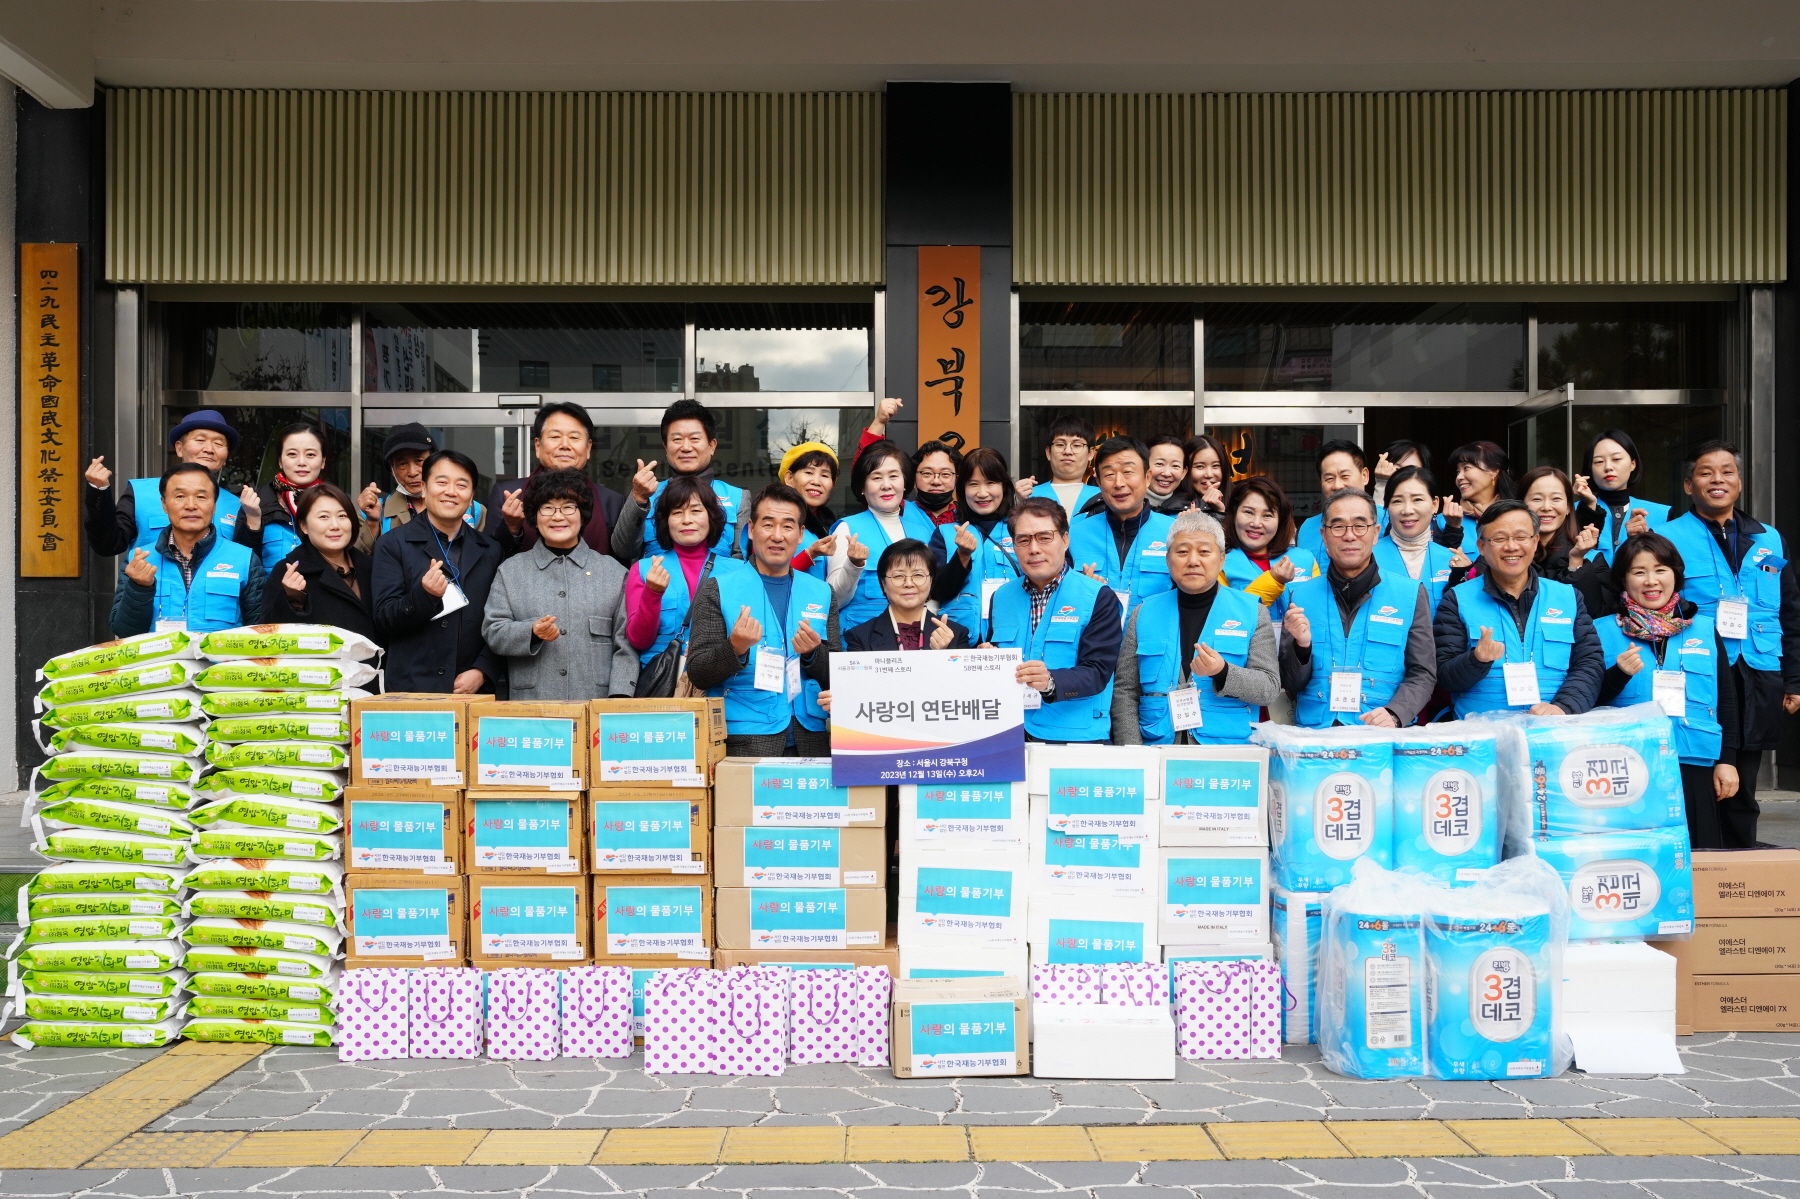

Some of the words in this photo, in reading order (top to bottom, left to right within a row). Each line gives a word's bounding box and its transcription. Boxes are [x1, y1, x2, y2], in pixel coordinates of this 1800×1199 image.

[970, 654, 1018, 662] 한국재능기부협회
[855, 700, 915, 723] 사랑의
[921, 698, 1001, 722] 연탄배달
[369, 730, 401, 743] 사랑의
[404, 730, 447, 743] 물품기부
[486, 736, 518, 748] 사랑의
[521, 737, 565, 749] 물품기부
[608, 732, 640, 744] 사랑의
[643, 731, 687, 743] 물품기부
[393, 763, 448, 773] 한국재능기부협회
[632, 764, 687, 774] 한국재능기부협회
[896, 760, 911, 768] 장소
[916, 759, 938, 767] 서울시
[939, 758, 968, 767] 강북구청
[509, 770, 563, 779] 한국재능기부협회
[881, 771, 906, 779] 2023년
[908, 771, 924, 779] 12월
[927, 770, 956, 779] 13일(수)
[958, 769, 984, 778] 오후2시
[1586, 758, 1611, 794] 3겹
[1610, 758, 1629, 796] 데코
[761, 778, 793, 790] 사랑의
[1172, 778, 1204, 788] 사랑의
[1208, 778, 1252, 790] 물품기부
[924, 791, 956, 802] 사랑의
[960, 791, 1004, 802] 물품기부
[1056, 786, 1089, 797] 사랑의
[1093, 786, 1137, 798] 물품기부
[1327, 798, 1361, 822] 3겹
[1435, 794, 1468, 818] 3겹
[785, 812, 840, 820] 한국재능기부협회
[1196, 812, 1250, 820] 한국재능기부협회
[358, 820, 390, 832] 사랑의
[393, 821, 436, 833] 물품기부
[482, 818, 514, 830] 사랑의
[517, 818, 561, 831] 물품기부
[603, 820, 635, 832] 사랑의
[639, 820, 683, 832] 물품기부
[1080, 820, 1136, 828] 한국재능기부협회
[1434, 819, 1469, 837] 데코
[1325, 824, 1361, 841] 데코
[752, 839, 784, 851] 사랑의
[788, 839, 832, 851] 물품기부
[1053, 837, 1085, 848] 사랑의
[382, 853, 436, 863] 한국재능기부협회
[505, 851, 561, 861] 한국재능기부협회
[627, 853, 683, 863] 한국재능기부협회
[776, 872, 831, 880] 한국재능기부협회
[1076, 872, 1132, 880] 한국재능기부협회
[1174, 876, 1206, 887] 사랑의
[1210, 876, 1254, 888] 물품기부
[924, 886, 956, 897] 사랑의
[960, 887, 1004, 899] 물품기부
[1595, 875, 1621, 909] 3겹
[1622, 872, 1640, 910] 데코
[1748, 890, 1774, 898] 디엔에이
[362, 907, 393, 920] 사랑의
[396, 907, 440, 920] 물품기부
[488, 906, 520, 918] 사랑의
[524, 906, 568, 918] 물품기부
[614, 905, 646, 917] 사랑의
[650, 905, 694, 917] 물품기부
[758, 902, 790, 913] 사랑의
[794, 902, 838, 913] 물품기부
[947, 920, 1002, 929] 한국재능기부협회
[386, 939, 441, 950] 한국재능기부협회
[512, 938, 568, 948] 한국재능기부협회
[638, 938, 694, 947] 한국재능기부협회
[1056, 937, 1088, 949] 사랑의
[1092, 938, 1136, 951] 물품기부
[1382, 943, 1396, 954] 3겹
[1719, 947, 1746, 955] 엘라스틴
[1483, 974, 1521, 1002] 3겹
[1720, 996, 1747, 1004] 여에스더
[1481, 1002, 1522, 1023] 데코
[1720, 1005, 1747, 1013] 엘라스틴
[1750, 1005, 1776, 1013] 디엔에이
[919, 1023, 954, 1036] 사랑의
[959, 1022, 1007, 1036] 물품기부
[947, 1058, 1007, 1068] 한국재능기부협회
